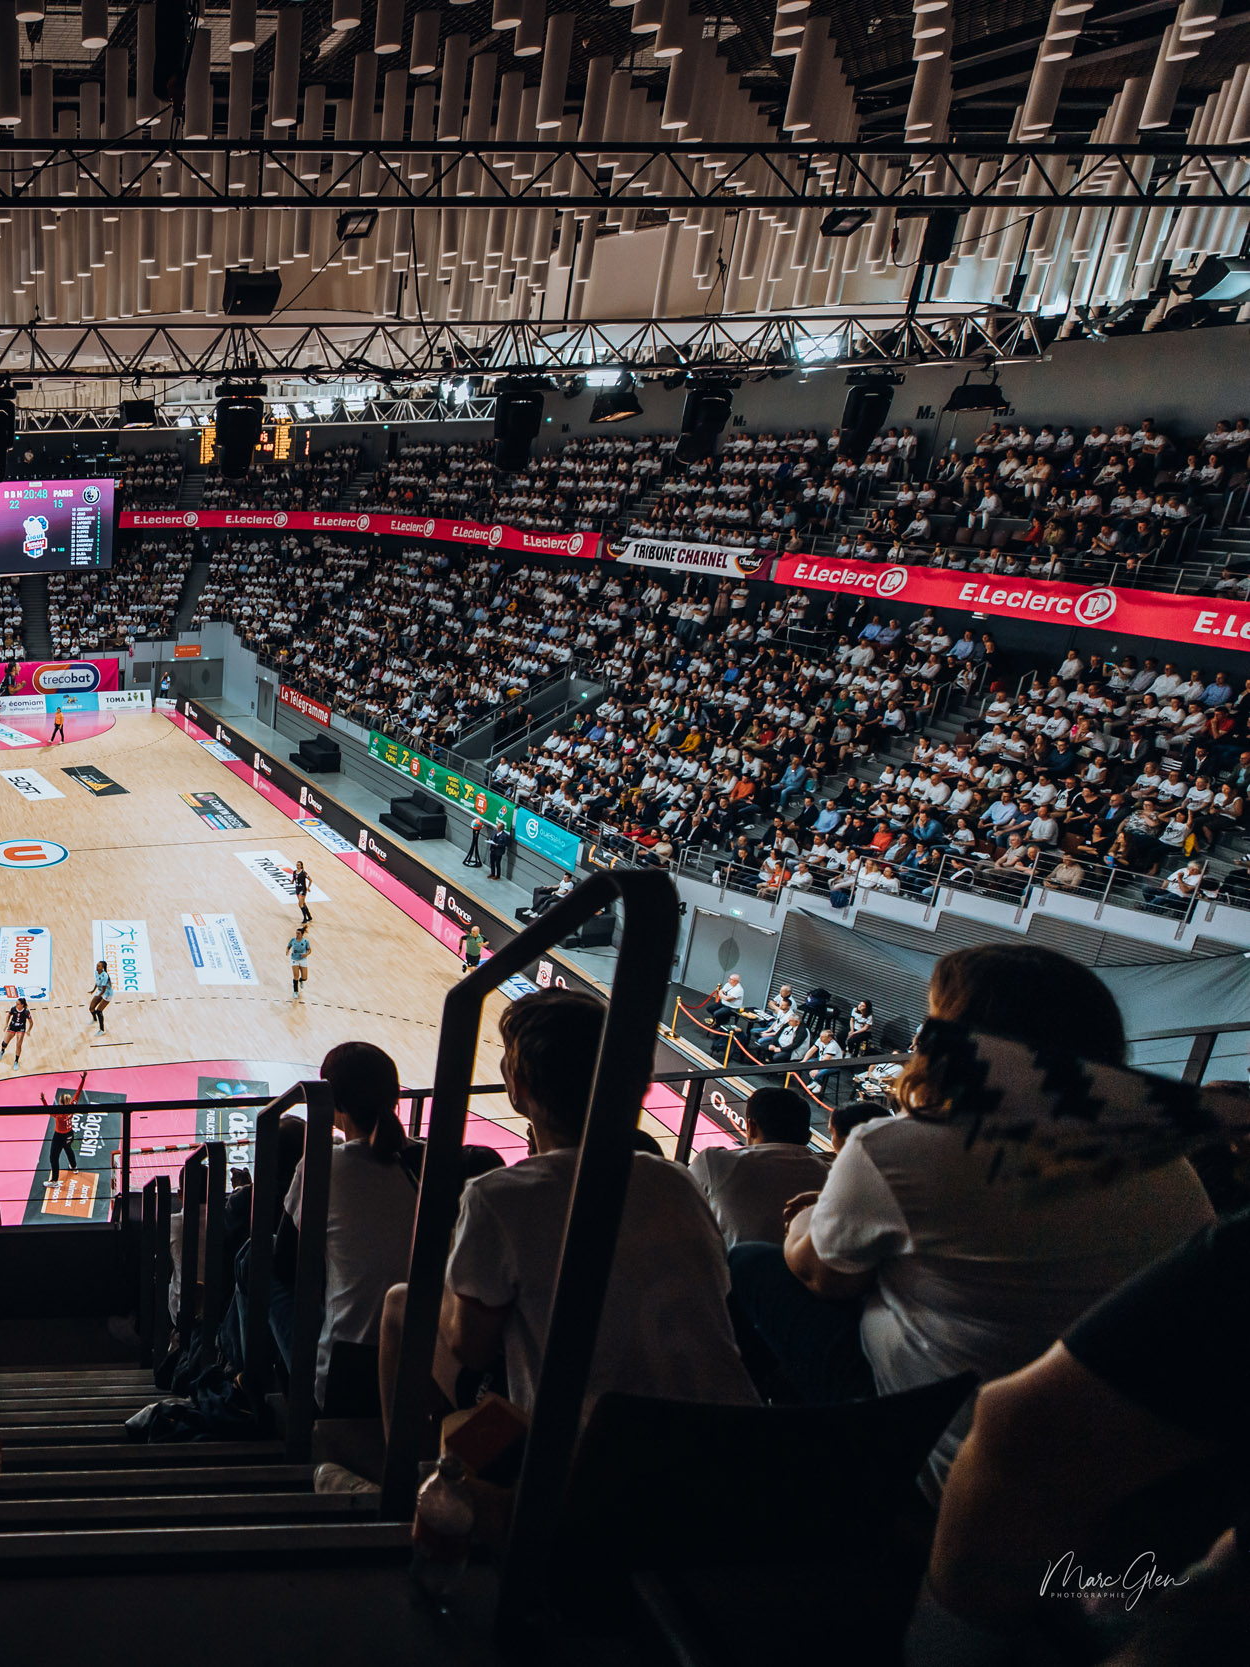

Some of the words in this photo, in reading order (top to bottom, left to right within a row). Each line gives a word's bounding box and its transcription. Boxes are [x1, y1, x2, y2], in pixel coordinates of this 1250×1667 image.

[23, 489, 48, 500] 20:48
[53, 490, 73, 498] PARIS
[9, 500, 20, 509] 22
[53, 499, 64, 508] 15
[133, 515, 182, 525] E.Leclerc
[225, 515, 273, 525] E.Leclerc
[313, 516, 356, 528] E.Leclerc
[390, 520, 424, 533] E.Leclerc
[452, 526, 489, 541] E.Leclerc
[523, 534, 568, 550] E.Leclerc
[633, 544, 677, 562] TRIBUNE
[677, 548, 728, 568] CHARNEL
[793, 563, 877, 588] E.Leclerc
[959, 582, 1074, 615] E.Leclerc
[42, 672, 91, 685] trecobat
[8, 698, 44, 707] écomiam
[281, 686, 289, 700] Le
[289, 688, 329, 723] Télégramme
[8, 776, 42, 795] SOFT
[10, 936, 35, 975] Butagaz
[711, 1091, 747, 1130] Onan
